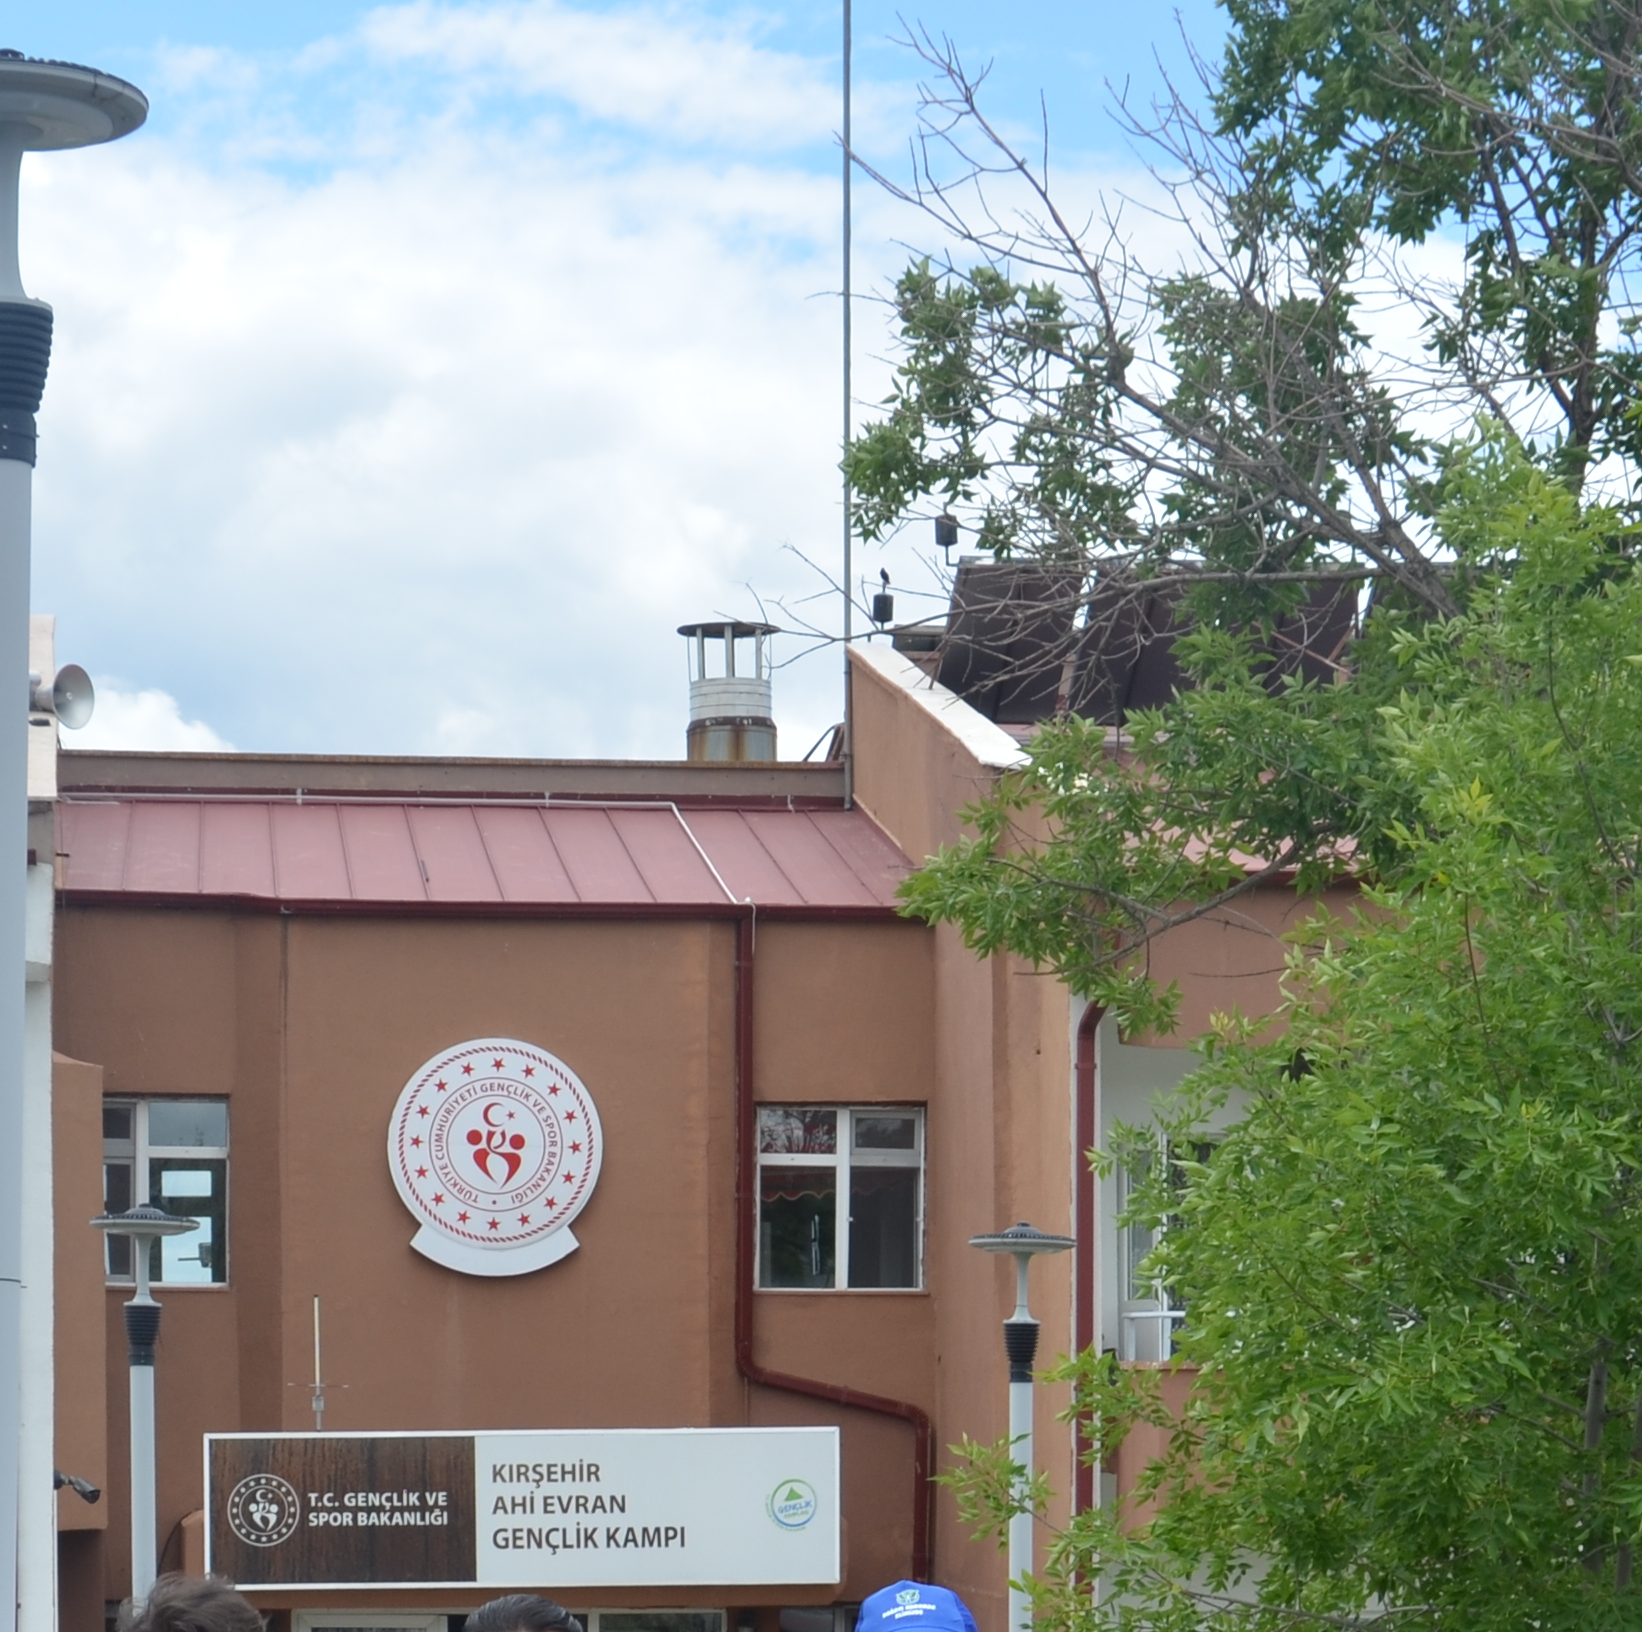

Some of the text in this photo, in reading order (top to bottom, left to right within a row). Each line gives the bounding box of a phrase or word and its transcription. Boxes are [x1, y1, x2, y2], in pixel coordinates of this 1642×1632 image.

[434, 1082, 557, 1204] TÜRKİYE CUMHURİYETİ GENÇLİK VE SPOR BAKANLIĞI
[492, 1458, 601, 1489] KIRŞEHİR
[308, 1489, 448, 1510] T.C. GENÇLİK VE
[492, 1491, 626, 1514] AHİ EVRAN
[308, 1508, 448, 1527] SPOR BAKANLIĞI
[492, 1521, 686, 1555] GENÇLİK KAMPI
